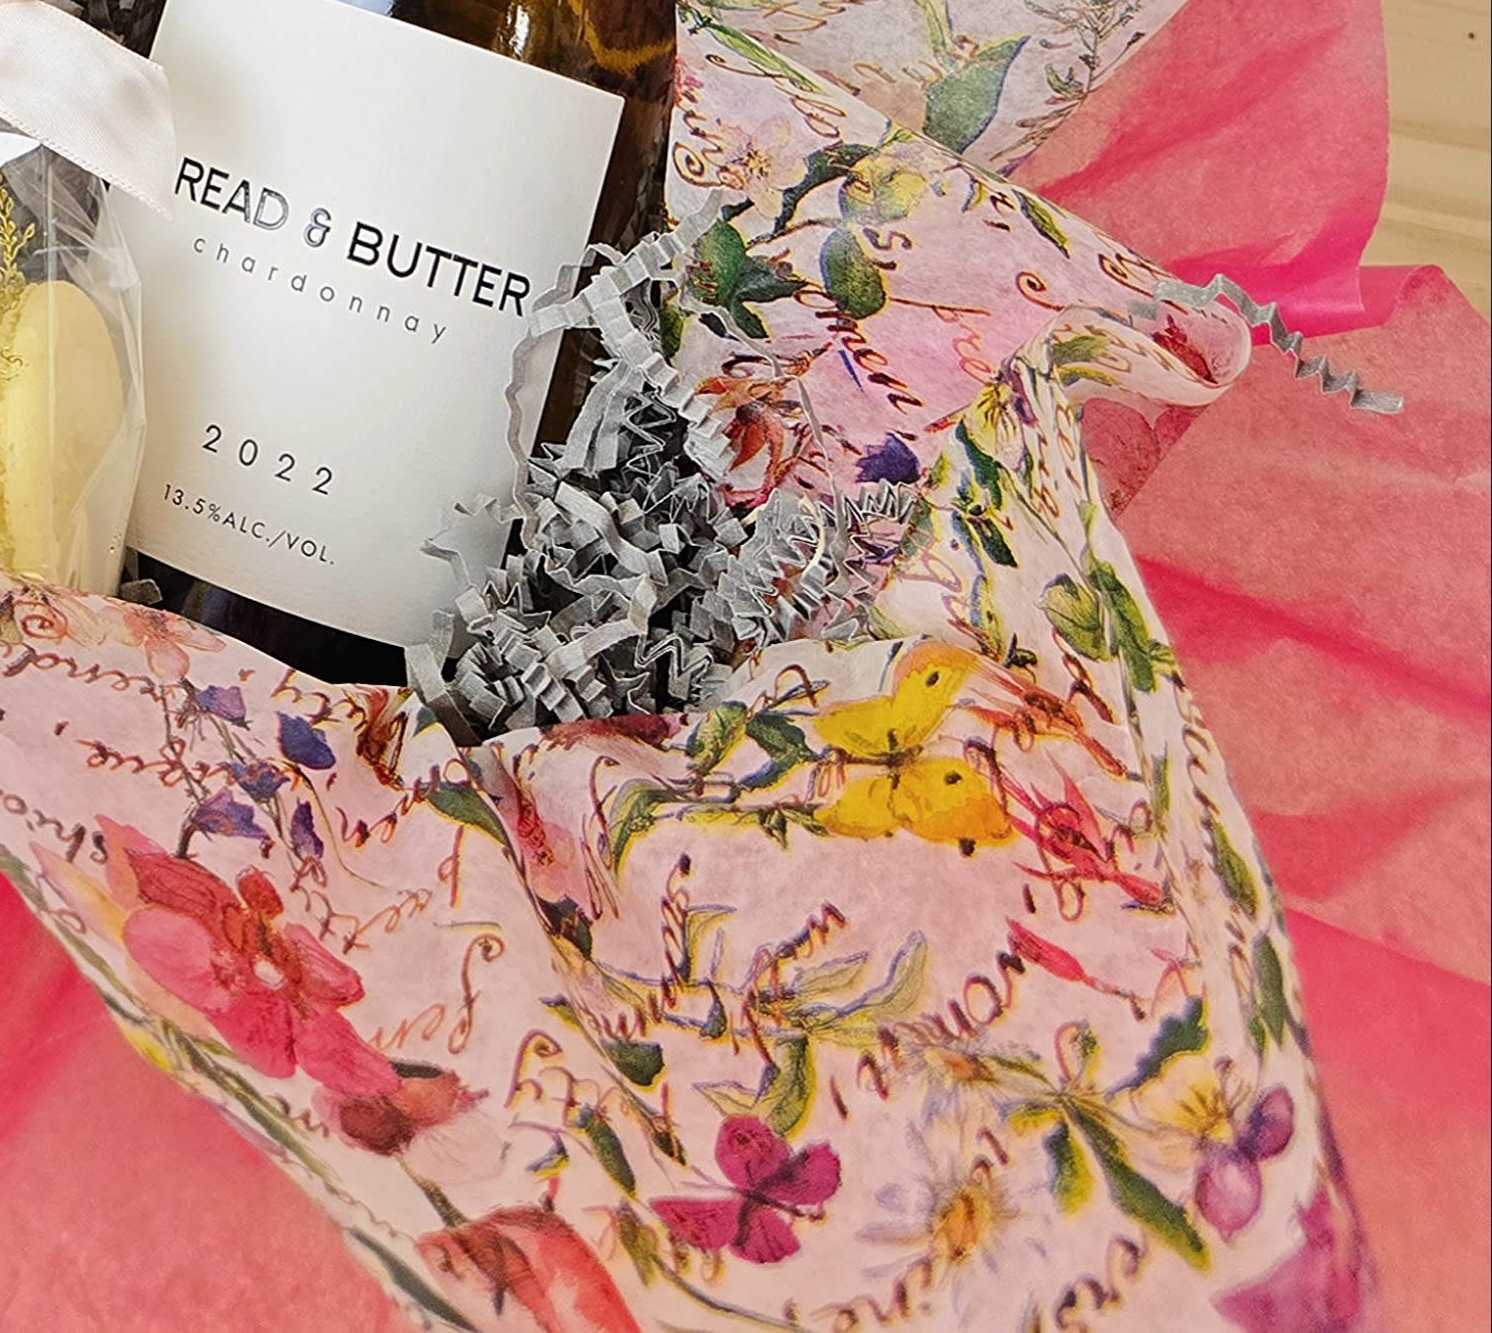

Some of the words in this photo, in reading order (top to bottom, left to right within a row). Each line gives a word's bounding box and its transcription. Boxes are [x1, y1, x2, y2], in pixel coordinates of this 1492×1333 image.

[174, 156, 288, 231] READ
[304, 207, 330, 249] &
[347, 221, 532, 316] BUTTER
[192, 235, 448, 345] chardonnay
[201, 423, 333, 496] 2022
